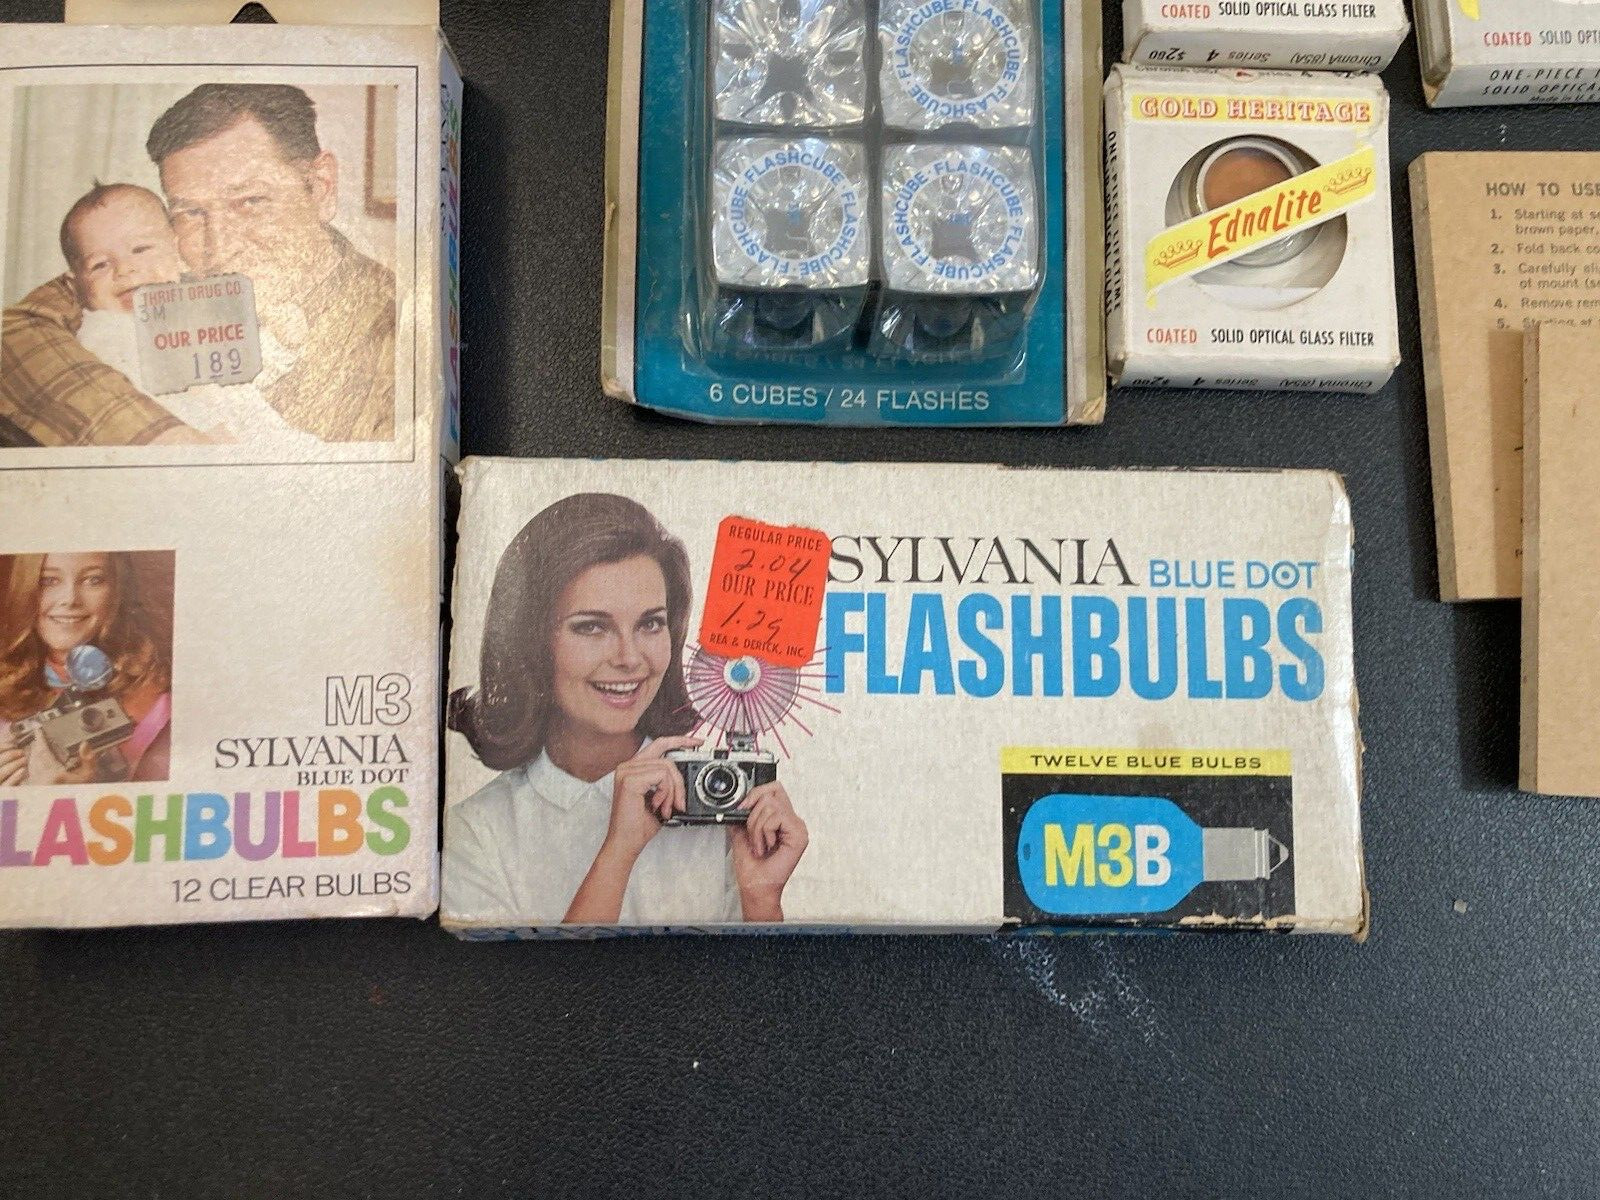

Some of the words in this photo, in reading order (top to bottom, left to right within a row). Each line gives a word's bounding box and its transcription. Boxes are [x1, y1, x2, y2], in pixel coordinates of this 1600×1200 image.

[1161, 5, 1211, 19] COATED
[1219, 2, 1250, 17] SOLID
[1256, 2, 1299, 17] OPTICAL
[1304, 4, 1338, 18] GLASS
[1342, 4, 1376, 19] FILTER
[895, 0, 953, 79] FLASHCUBE
[963, 0, 1019, 82] FLASHCUBE
[1484, 31, 1532, 47] COATED
[1539, 30, 1572, 45] SOLID
[1206, 51, 1221, 62] 4
[1229, 50, 1272, 62] Series
[1490, 67, 1585, 81] ONE-PIECE
[909, 85, 1007, 118] FLASHCUBE
[1482, 85, 1530, 95] SOLID
[1140, 97, 1218, 118] GOLD
[1228, 99, 1371, 123] HERITAGE
[745, 152, 845, 185] FLASHCUBE
[934, 160, 1023, 217] FLASHCUBE
[1485, 182, 1526, 197] HOW
[1537, 182, 1560, 197] TO
[894, 171, 929, 265] FLASHCUBE
[1207, 189, 1322, 259] EdnaLite
[1490, 208, 1502, 220] 1.
[1514, 208, 1566, 222] Starting
[1571, 209, 1584, 220] at
[731, 186, 789, 274] FLASHCUBE
[800, 190, 857, 276] FLASHCUBE
[1515, 225, 1554, 235] brown
[934, 226, 1023, 279] FLASHCUBE
[1490, 243, 1504, 255] 2.
[1517, 243, 1544, 254] Fold
[1550, 243, 1580, 254] back
[1492, 263, 1506, 275] 3.
[1518, 262, 1576, 276] Carefully
[188, 282, 222, 300] DRUG
[1520, 278, 1533, 289] of
[1537, 278, 1579, 289] mount
[1493, 298, 1507, 309] 4.
[1520, 297, 1573, 309] Remove
[154, 331, 190, 351] OUR
[197, 323, 244, 345] PRICE
[1147, 328, 1198, 344] COATED
[1211, 328, 1244, 343] SOLID
[1250, 329, 1295, 345] OPTICAL
[1300, 330, 1335, 346] GLASS
[1339, 330, 1375, 346] FILTER
[709, 383, 723, 402] 6
[732, 385, 818, 407] CUBES
[824, 388, 834, 407] /
[840, 389, 867, 408] 24
[876, 389, 990, 411] FLASHES
[729, 525, 783, 544] REGULAR
[786, 534, 823, 551] PRICE
[828, 535, 1140, 586] SYLVANIA
[1149, 560, 1235, 589] BLUE
[1246, 560, 1320, 591] DOT
[722, 572, 756, 597] OUR
[763, 579, 814, 606] PRICE
[709, 633, 728, 645] REA
[731, 636, 739, 647] &
[826, 592, 1326, 702] FLASHBULBS
[325, 672, 412, 726] M3
[215, 733, 410, 769] SYLVANIA
[1030, 754, 1117, 768] TWELVE
[1126, 755, 1182, 769] BLUE
[1192, 756, 1262, 770] BULBS
[297, 769, 354, 786] BLUE
[361, 768, 409, 785] DOT
[1044, 823, 1172, 888] M3B
[172, 879, 202, 903] 12
[210, 876, 305, 901] CLEAR
[316, 871, 412, 897] BULBS
